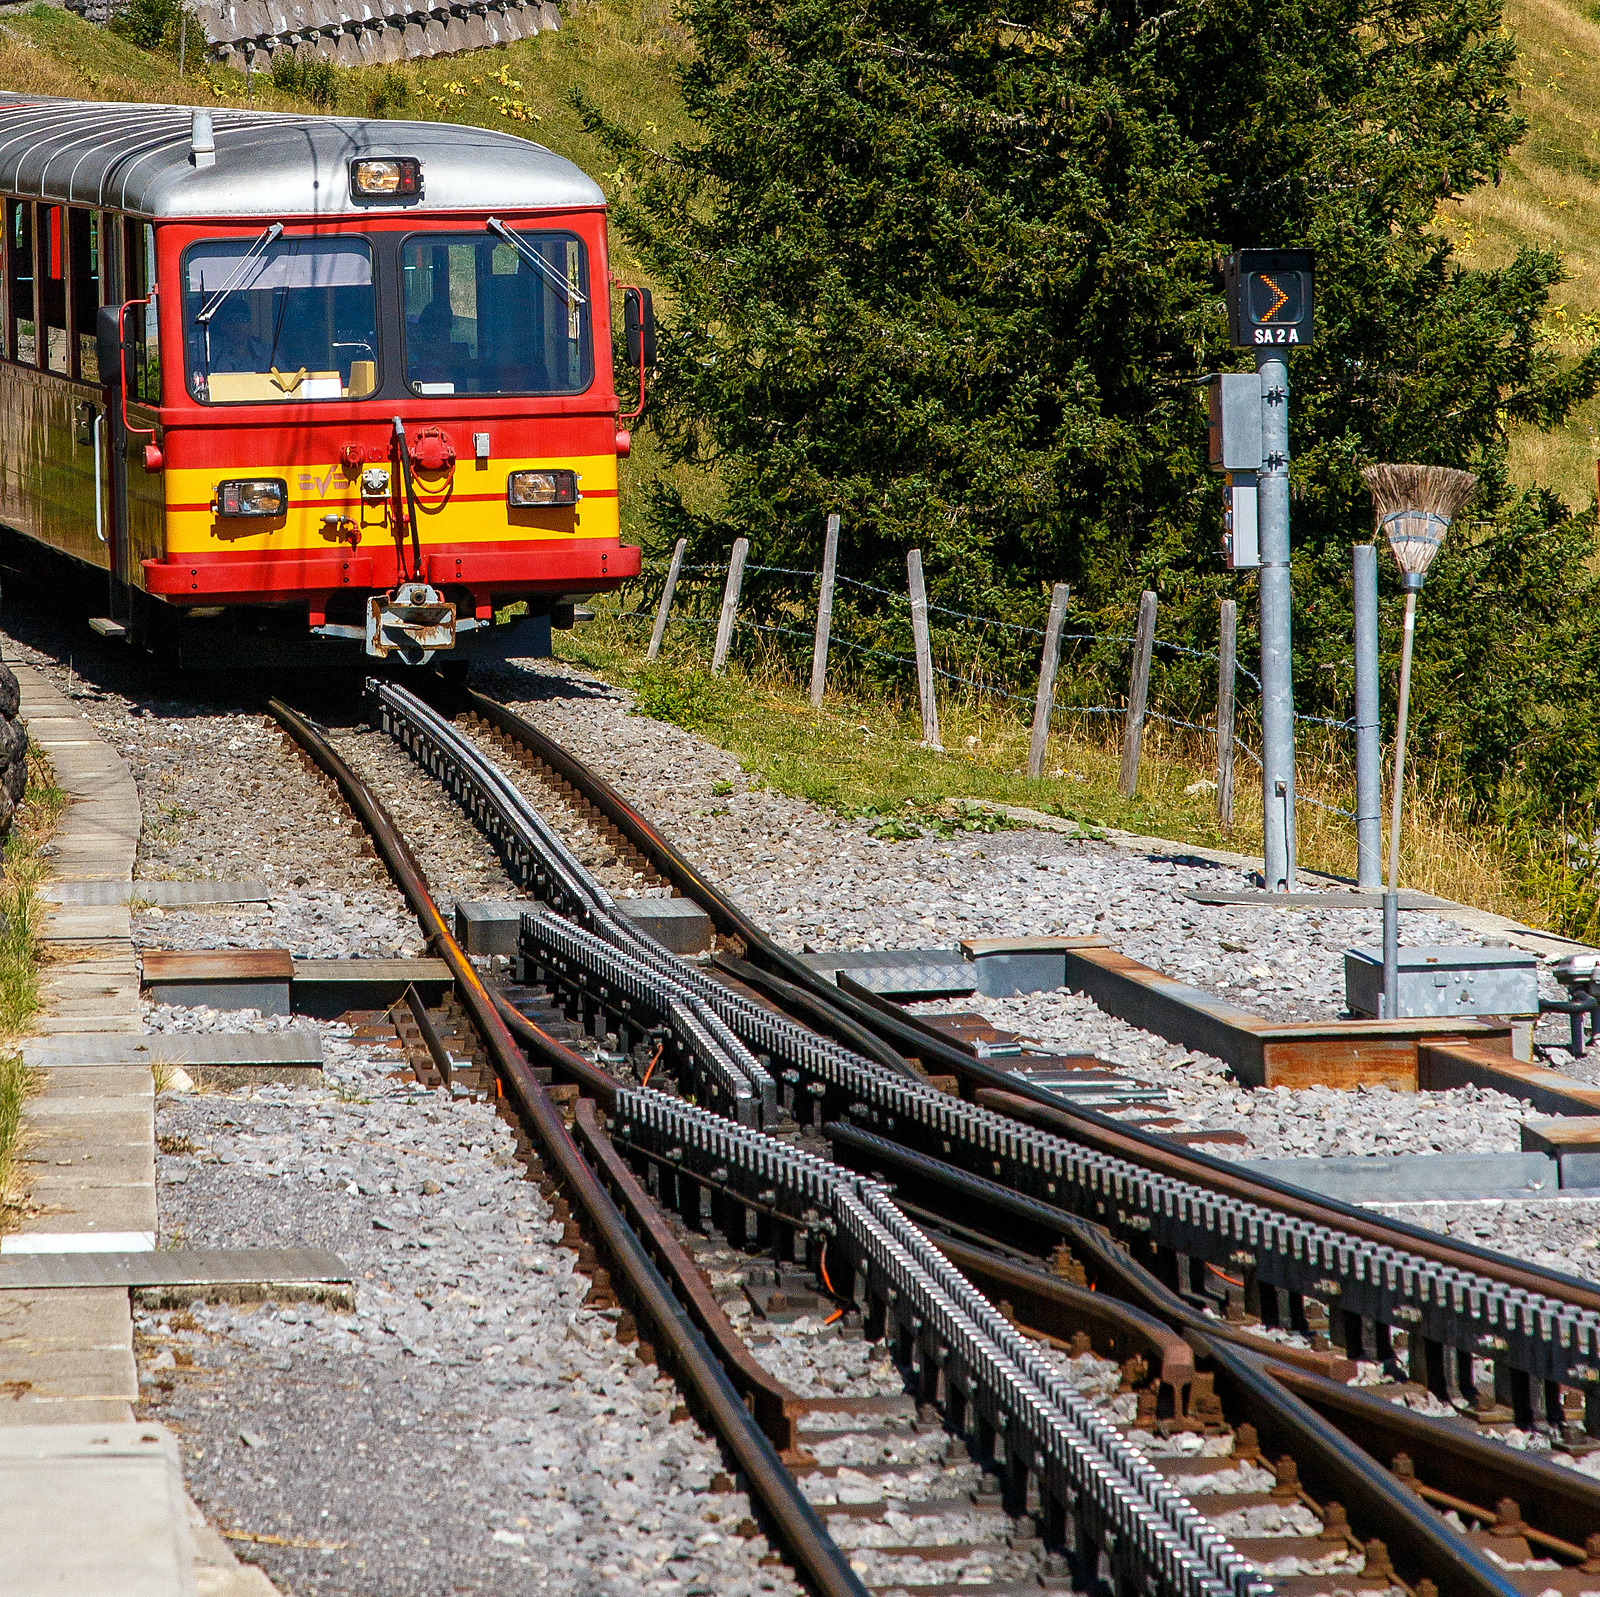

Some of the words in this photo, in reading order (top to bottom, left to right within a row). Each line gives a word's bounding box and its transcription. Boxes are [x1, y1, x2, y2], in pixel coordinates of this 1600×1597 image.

[1254, 328, 1274, 344] SA
[1276, 328, 1286, 343] 2
[1288, 328, 1299, 343] A
